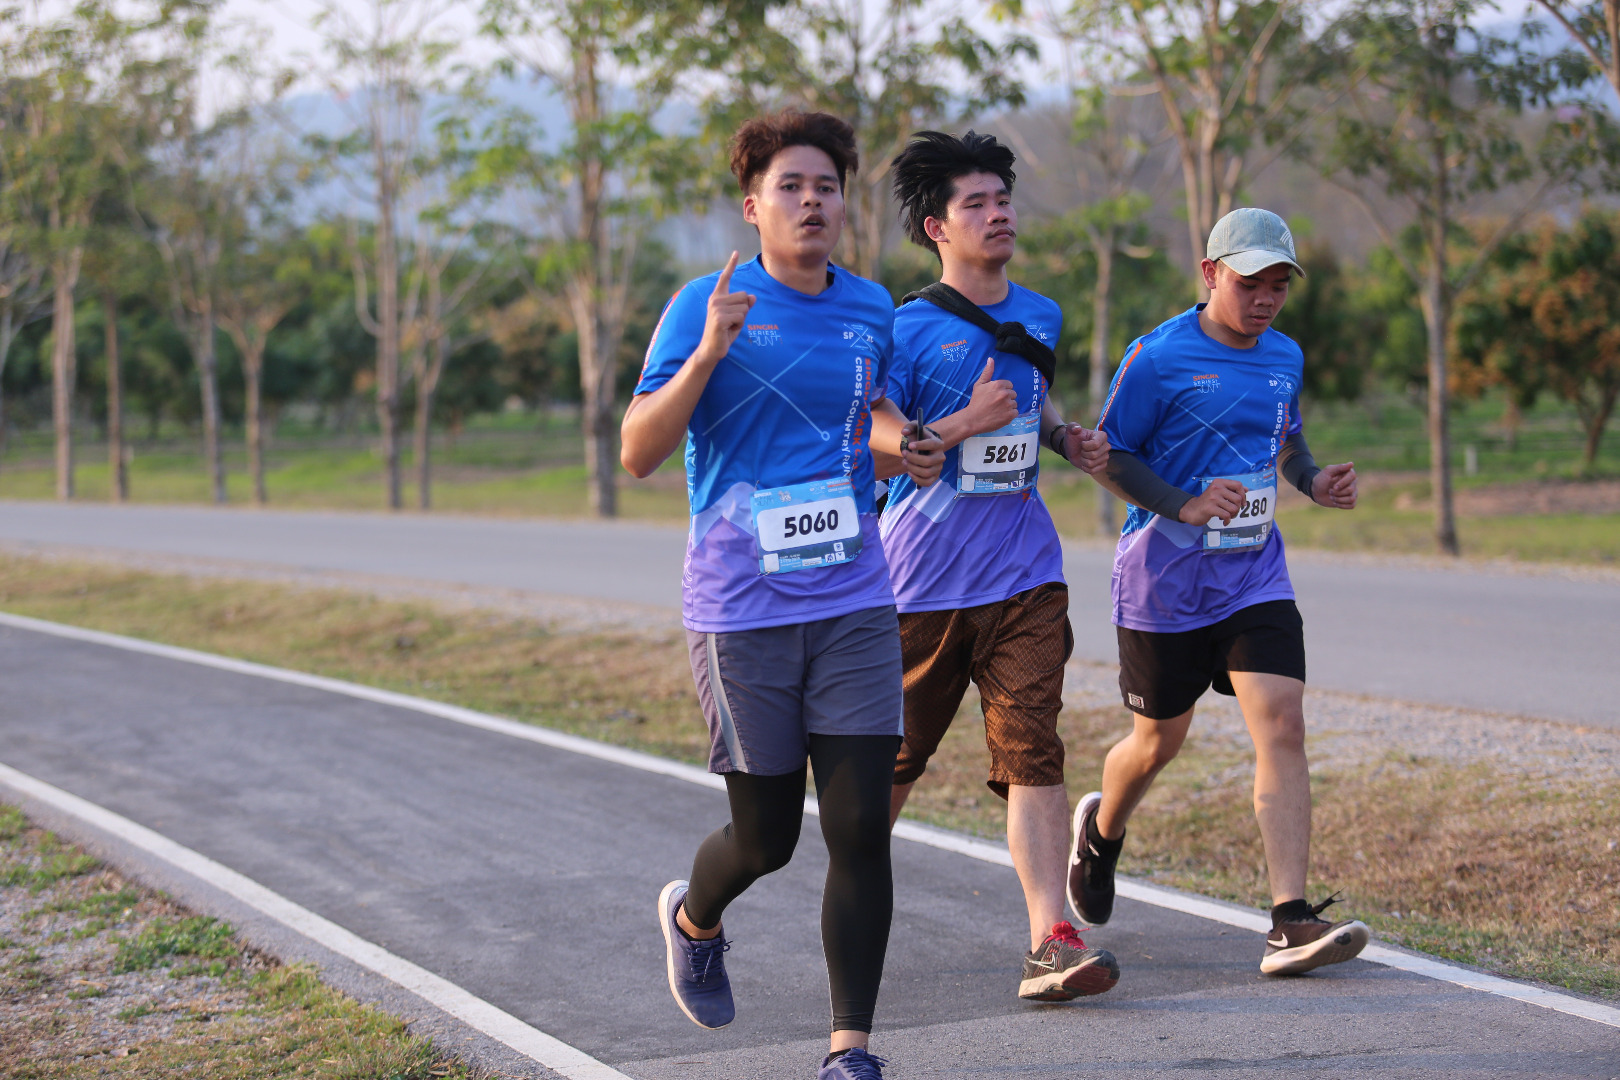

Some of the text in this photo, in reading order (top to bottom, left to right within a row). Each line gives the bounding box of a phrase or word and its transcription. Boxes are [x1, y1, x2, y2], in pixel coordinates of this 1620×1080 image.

[855, 356, 863, 397] CROSS
[841, 399, 860, 453] COUNTRY
[852, 412, 868, 445] PARK
[1273, 402, 1283, 435] CROSS
[983, 442, 1027, 464] 5261
[784, 509, 839, 538] 5060
[1239, 496, 1267, 519] 280
